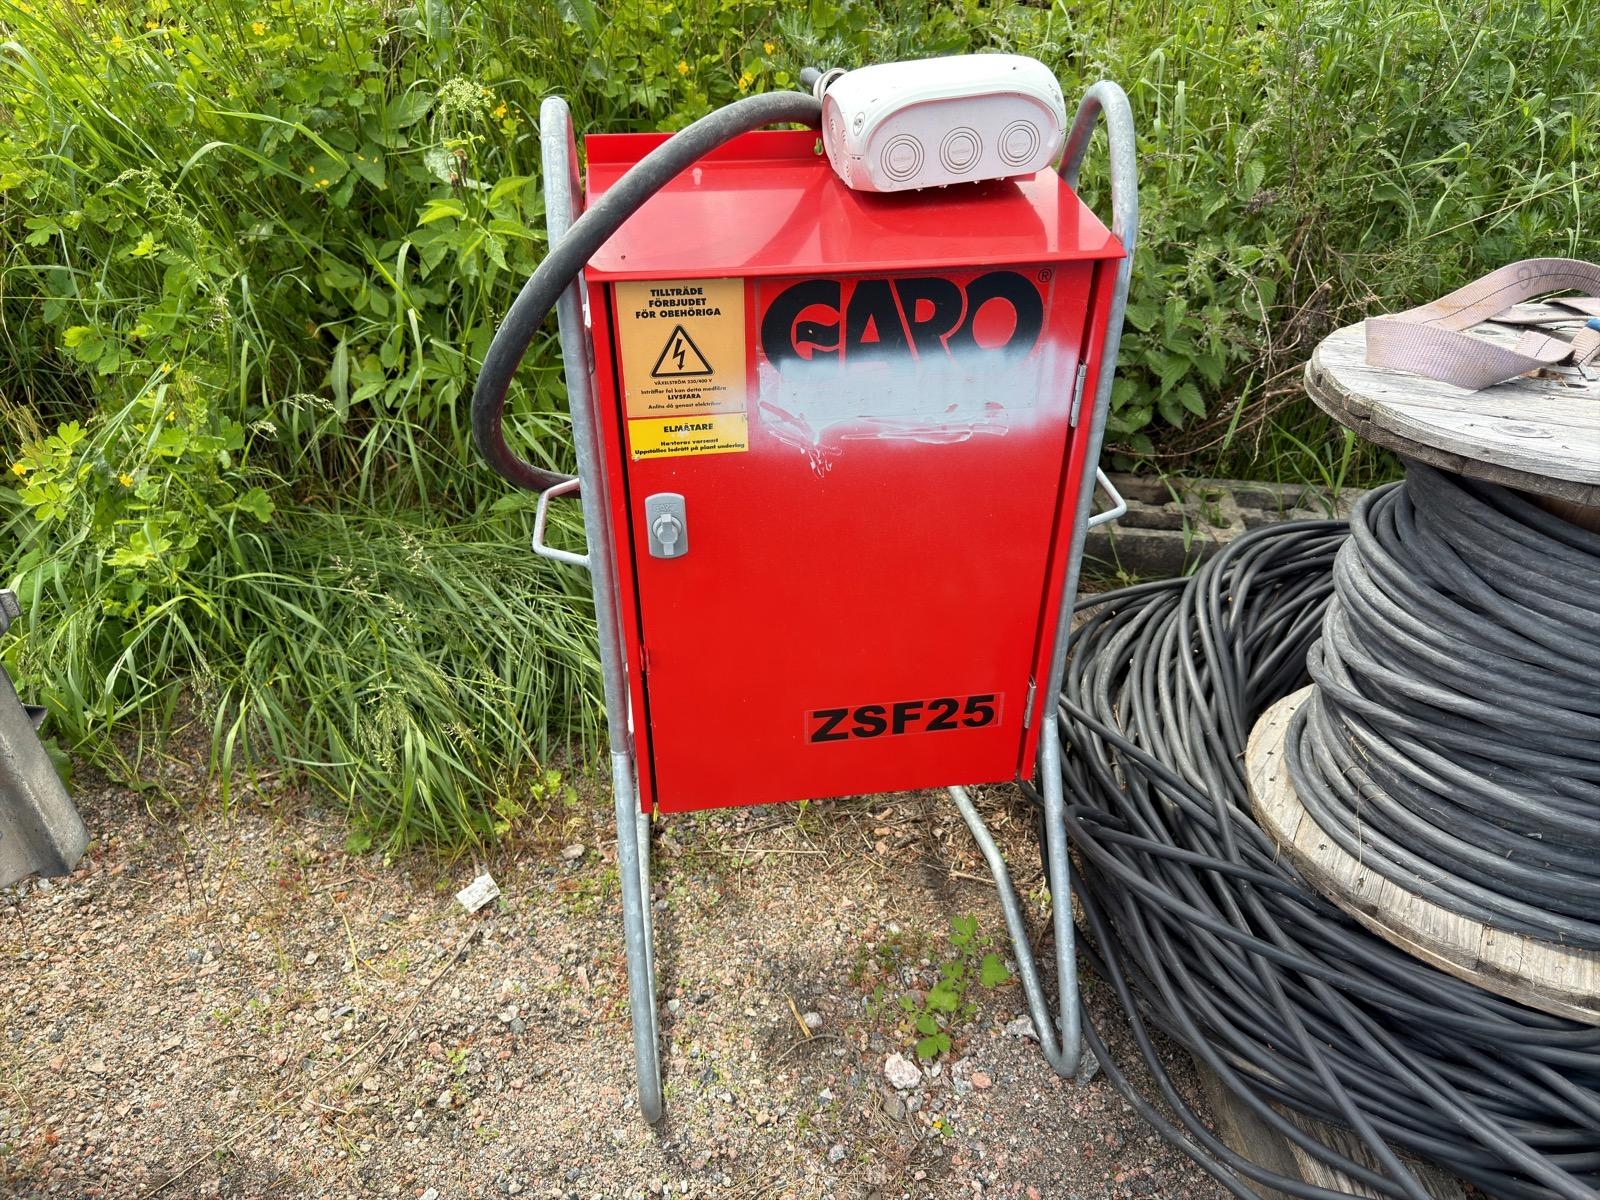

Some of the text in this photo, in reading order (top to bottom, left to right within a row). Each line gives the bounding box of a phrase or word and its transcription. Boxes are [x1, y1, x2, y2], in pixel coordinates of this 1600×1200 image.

[650, 286, 703, 297] TILLTRÄDE
[648, 298, 707, 308] FÖRBJUDET
[635, 307, 722, 319] FÖR OBEHÖRIGA
[761, 270, 1044, 373] GARO
[663, 422, 713, 433] ELMÄTARE
[811, 695, 995, 742] ZSF25
